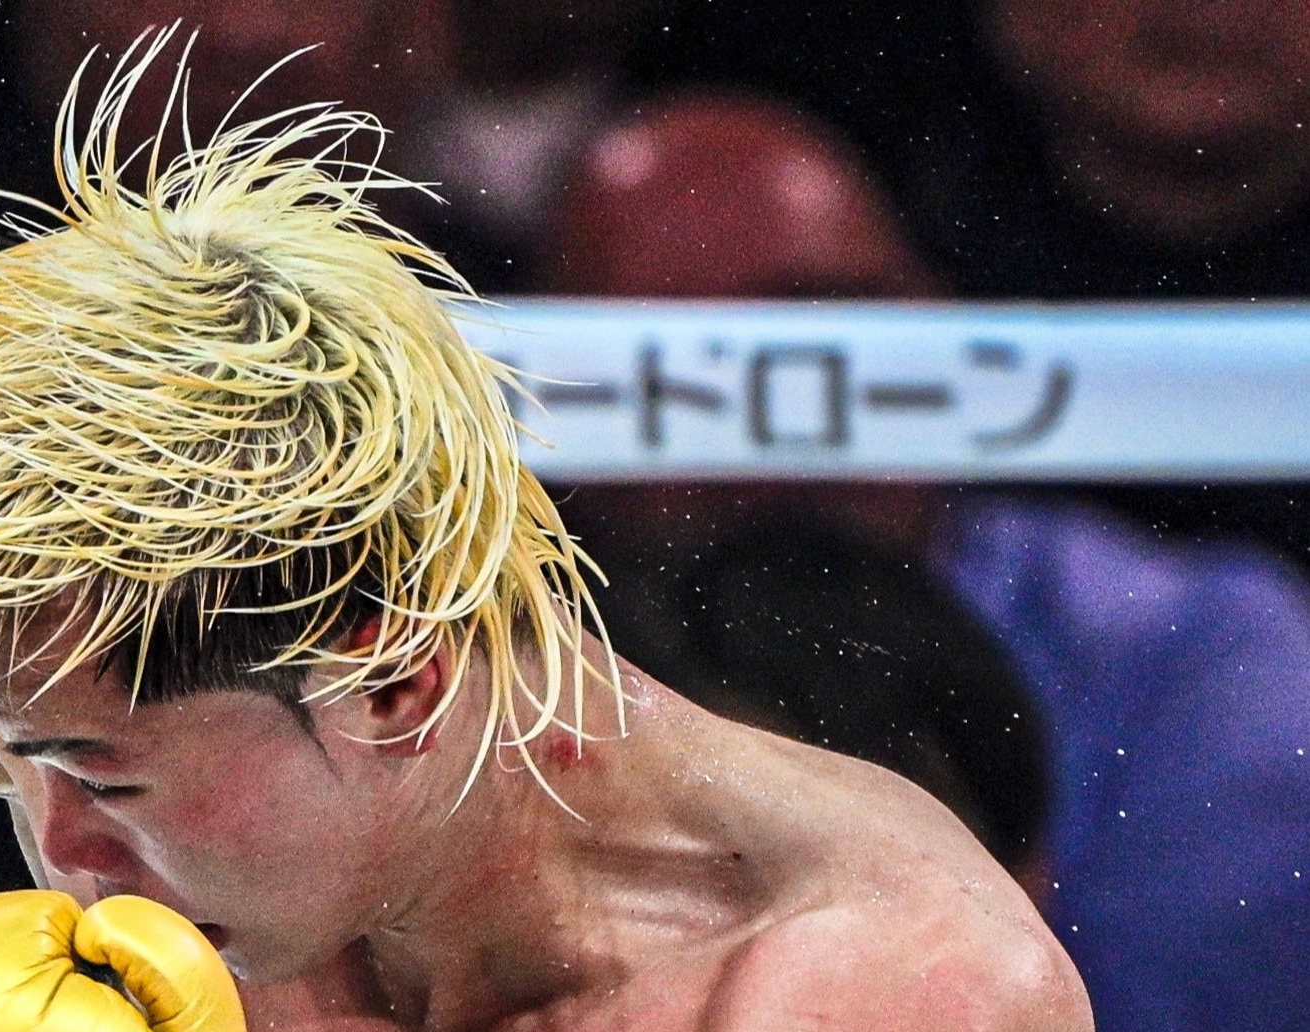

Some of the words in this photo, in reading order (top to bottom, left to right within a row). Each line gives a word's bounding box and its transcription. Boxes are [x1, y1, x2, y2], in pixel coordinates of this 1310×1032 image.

[492, 336, 1076, 450] ードローン
